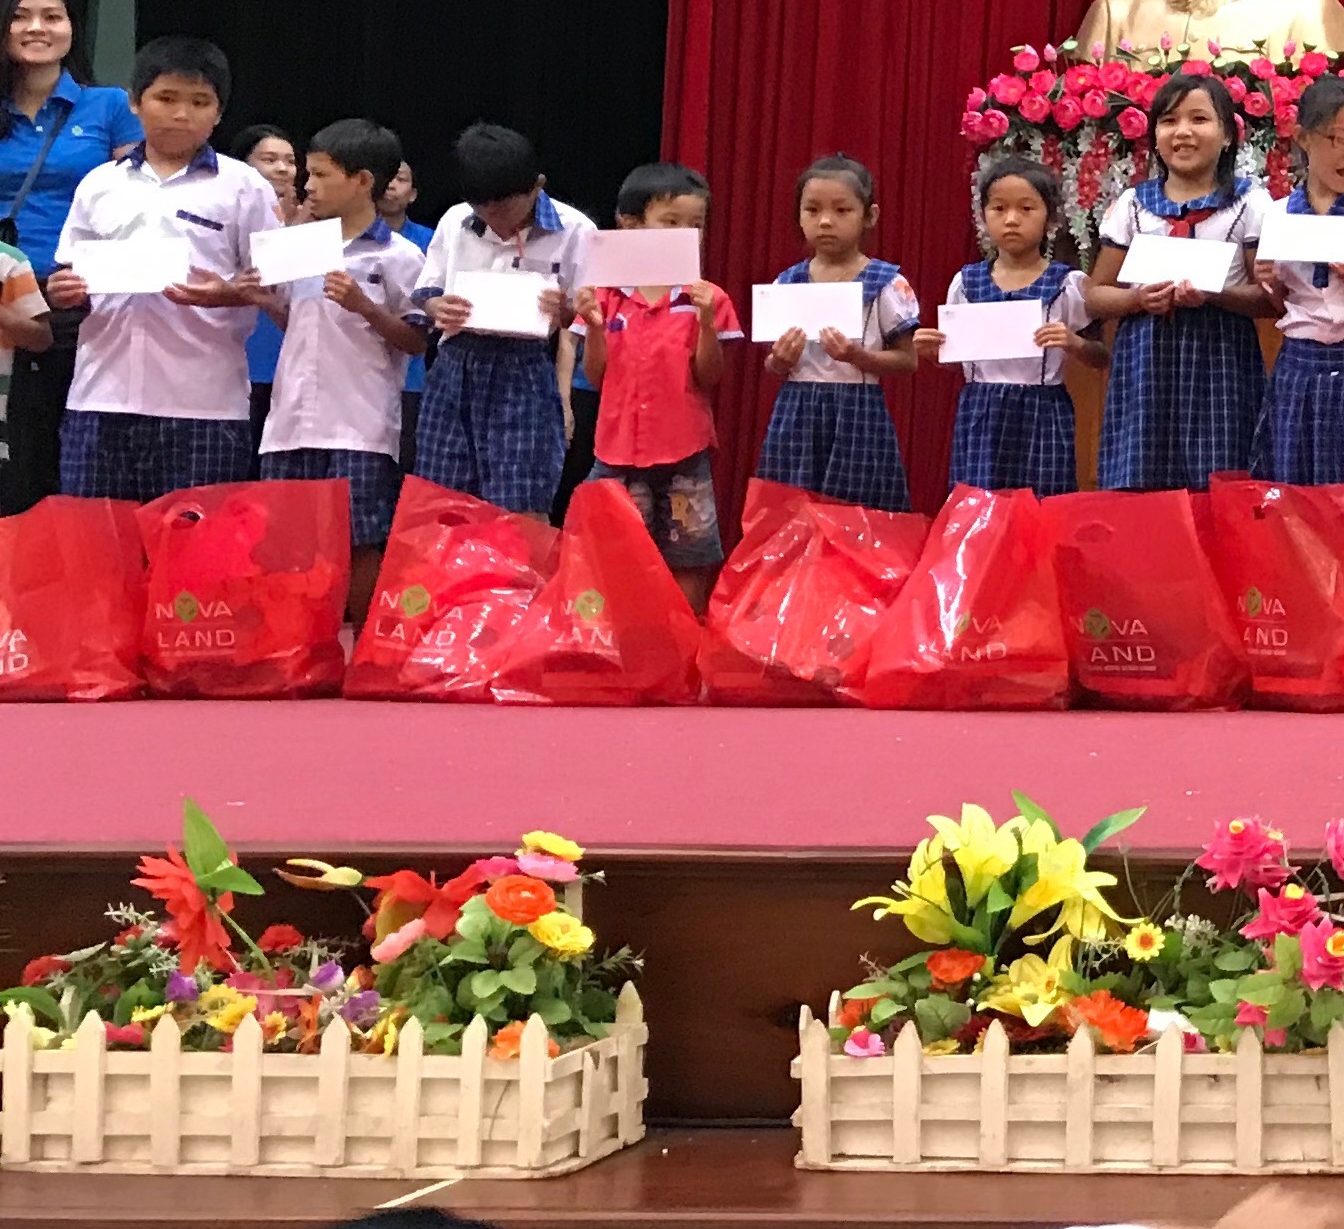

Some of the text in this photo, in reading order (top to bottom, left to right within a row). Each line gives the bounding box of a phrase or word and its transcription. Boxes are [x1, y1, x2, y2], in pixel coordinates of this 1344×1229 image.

[157, 629, 235, 648] LAND
[375, 620, 456, 646] LAND
[1090, 645, 1156, 663] AND
